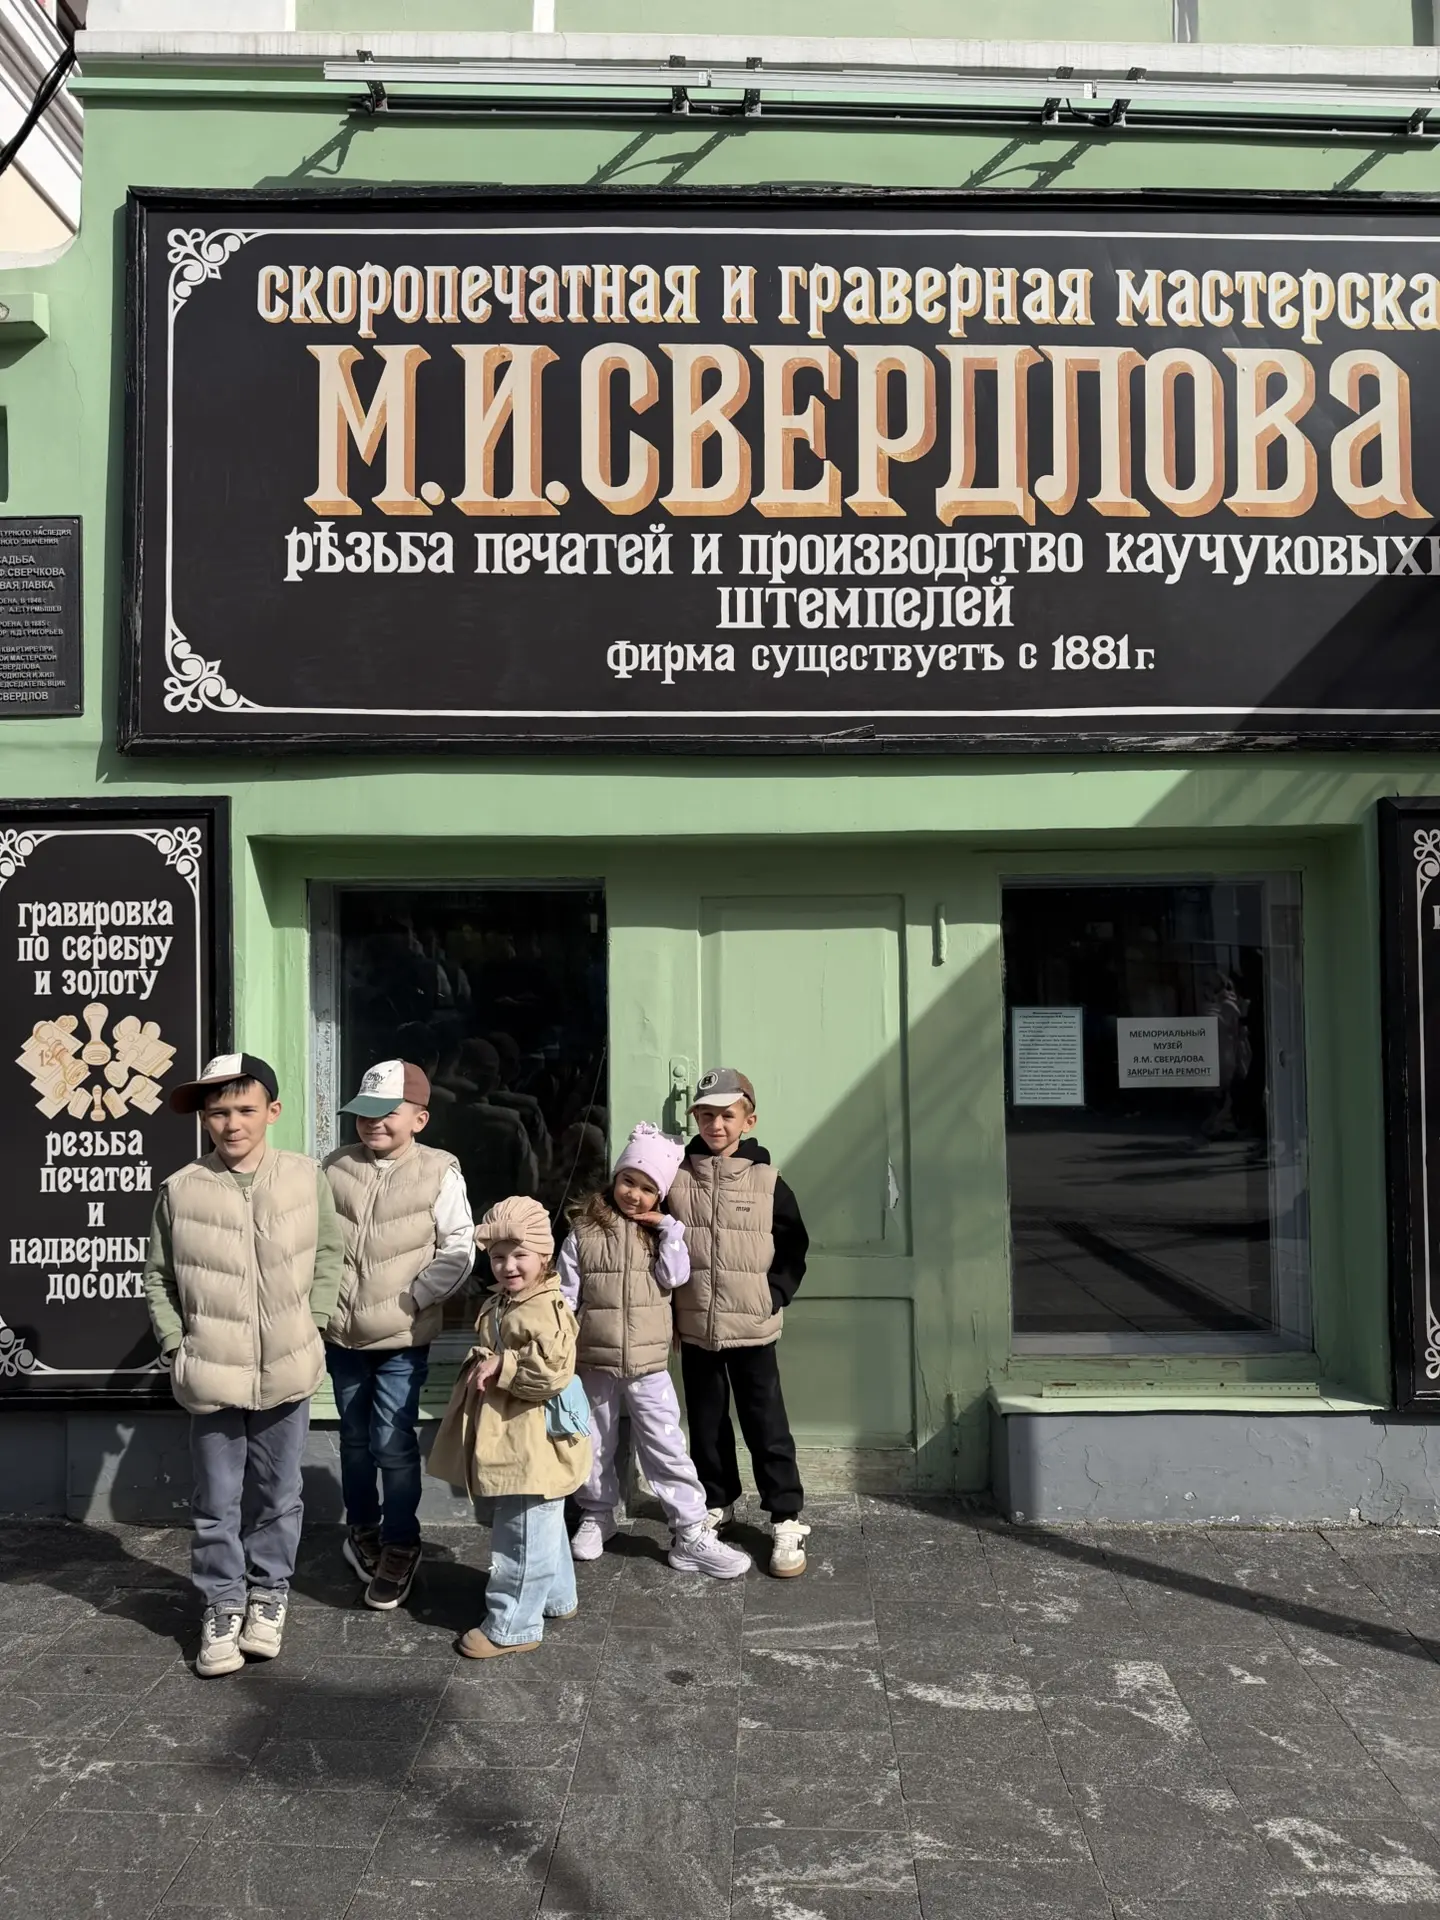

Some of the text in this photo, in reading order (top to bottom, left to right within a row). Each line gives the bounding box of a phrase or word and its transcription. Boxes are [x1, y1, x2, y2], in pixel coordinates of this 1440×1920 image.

[257, 262, 701, 338] скоропечатная
[721, 264, 758, 325] и
[777, 262, 1095, 338] граверная
[0, 555, 36, 564] АДЬБА
[474, 523, 674, 576] печатей
[691, 532, 723, 575] и
[739, 531, 1084, 583] производство
[22, 580, 55, 589] ЛАВКА
[716, 576, 1015, 629] штемпелей
[606, 640, 735, 684] Фирма
[1018, 641, 1038, 670] с
[18, 899, 174, 936] гравировка
[17, 934, 173, 969] по серебру
[34, 969, 159, 1000] и золоту
[1129, 1028, 1206, 1038] МЕМОРИАЛЬНЫЙ
[1153, 1040, 1183, 1050] МУЗЕЙ
[1127, 1066, 1212, 1076] ЗАКРЫТ НА РЕМОНТ
[1133, 1055, 1204, 1064] Я.М. СВЕРДЛОВА
[45, 1130, 143, 1165] резьба
[40, 1160, 153, 1193] печатей
[87, 1202, 106, 1227] и
[9, 1236, 151, 1272] надверны
